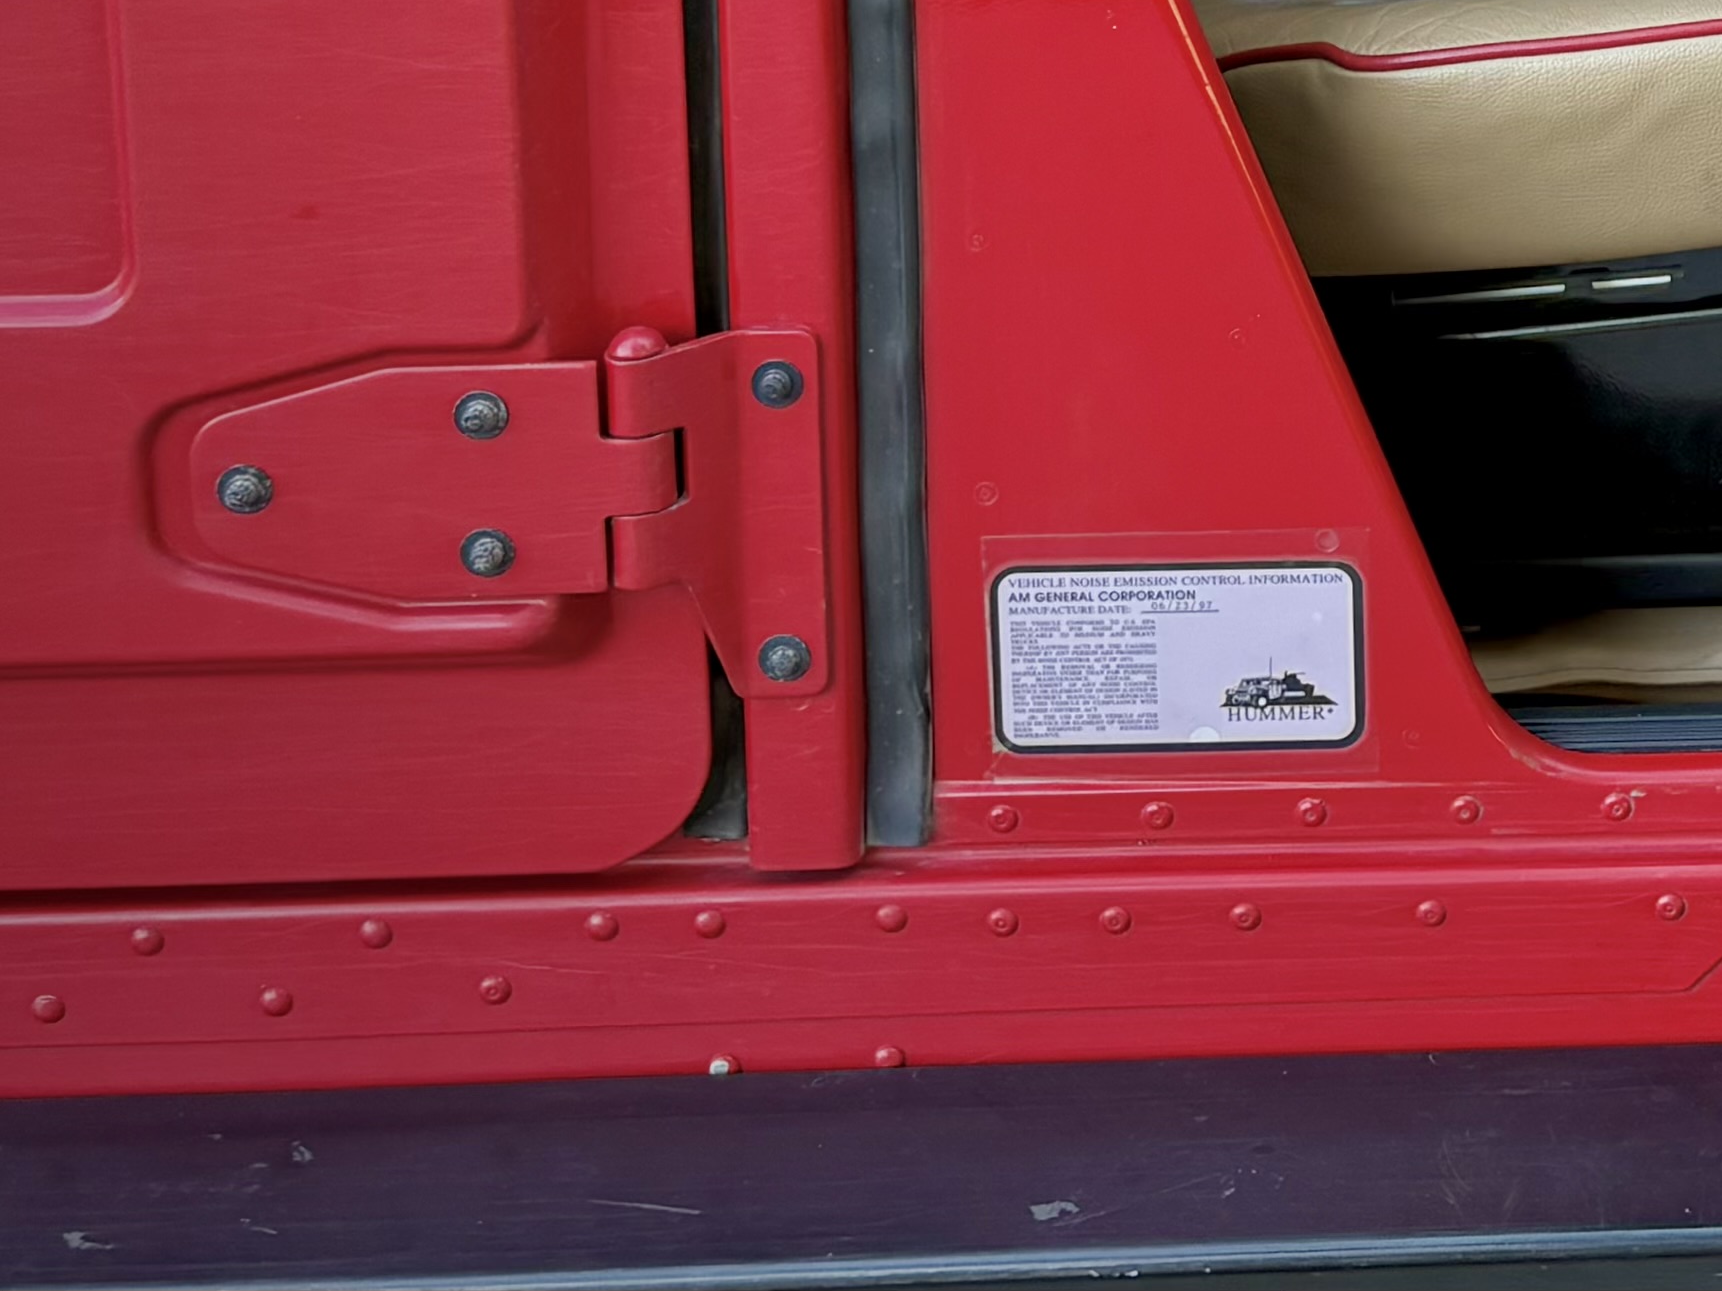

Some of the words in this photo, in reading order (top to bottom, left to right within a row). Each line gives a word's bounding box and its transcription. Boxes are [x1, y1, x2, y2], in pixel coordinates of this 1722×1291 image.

[1008, 577, 1066, 589] VEHICLE
[1070, 576, 1110, 588] NOISE
[1114, 575, 1178, 587] EMISSION
[1181, 574, 1245, 586] CONTROL
[1249, 573, 1343, 585] INFORMATION
[1008, 592, 1031, 603] AM
[1034, 591, 1094, 603] GENERAL
[1098, 589, 1196, 602] CORPORATION
[1009, 605, 1095, 616] MANUFACTURE
[1098, 604, 1132, 615] DATE:
[1227, 705, 1326, 722] HUMMER
